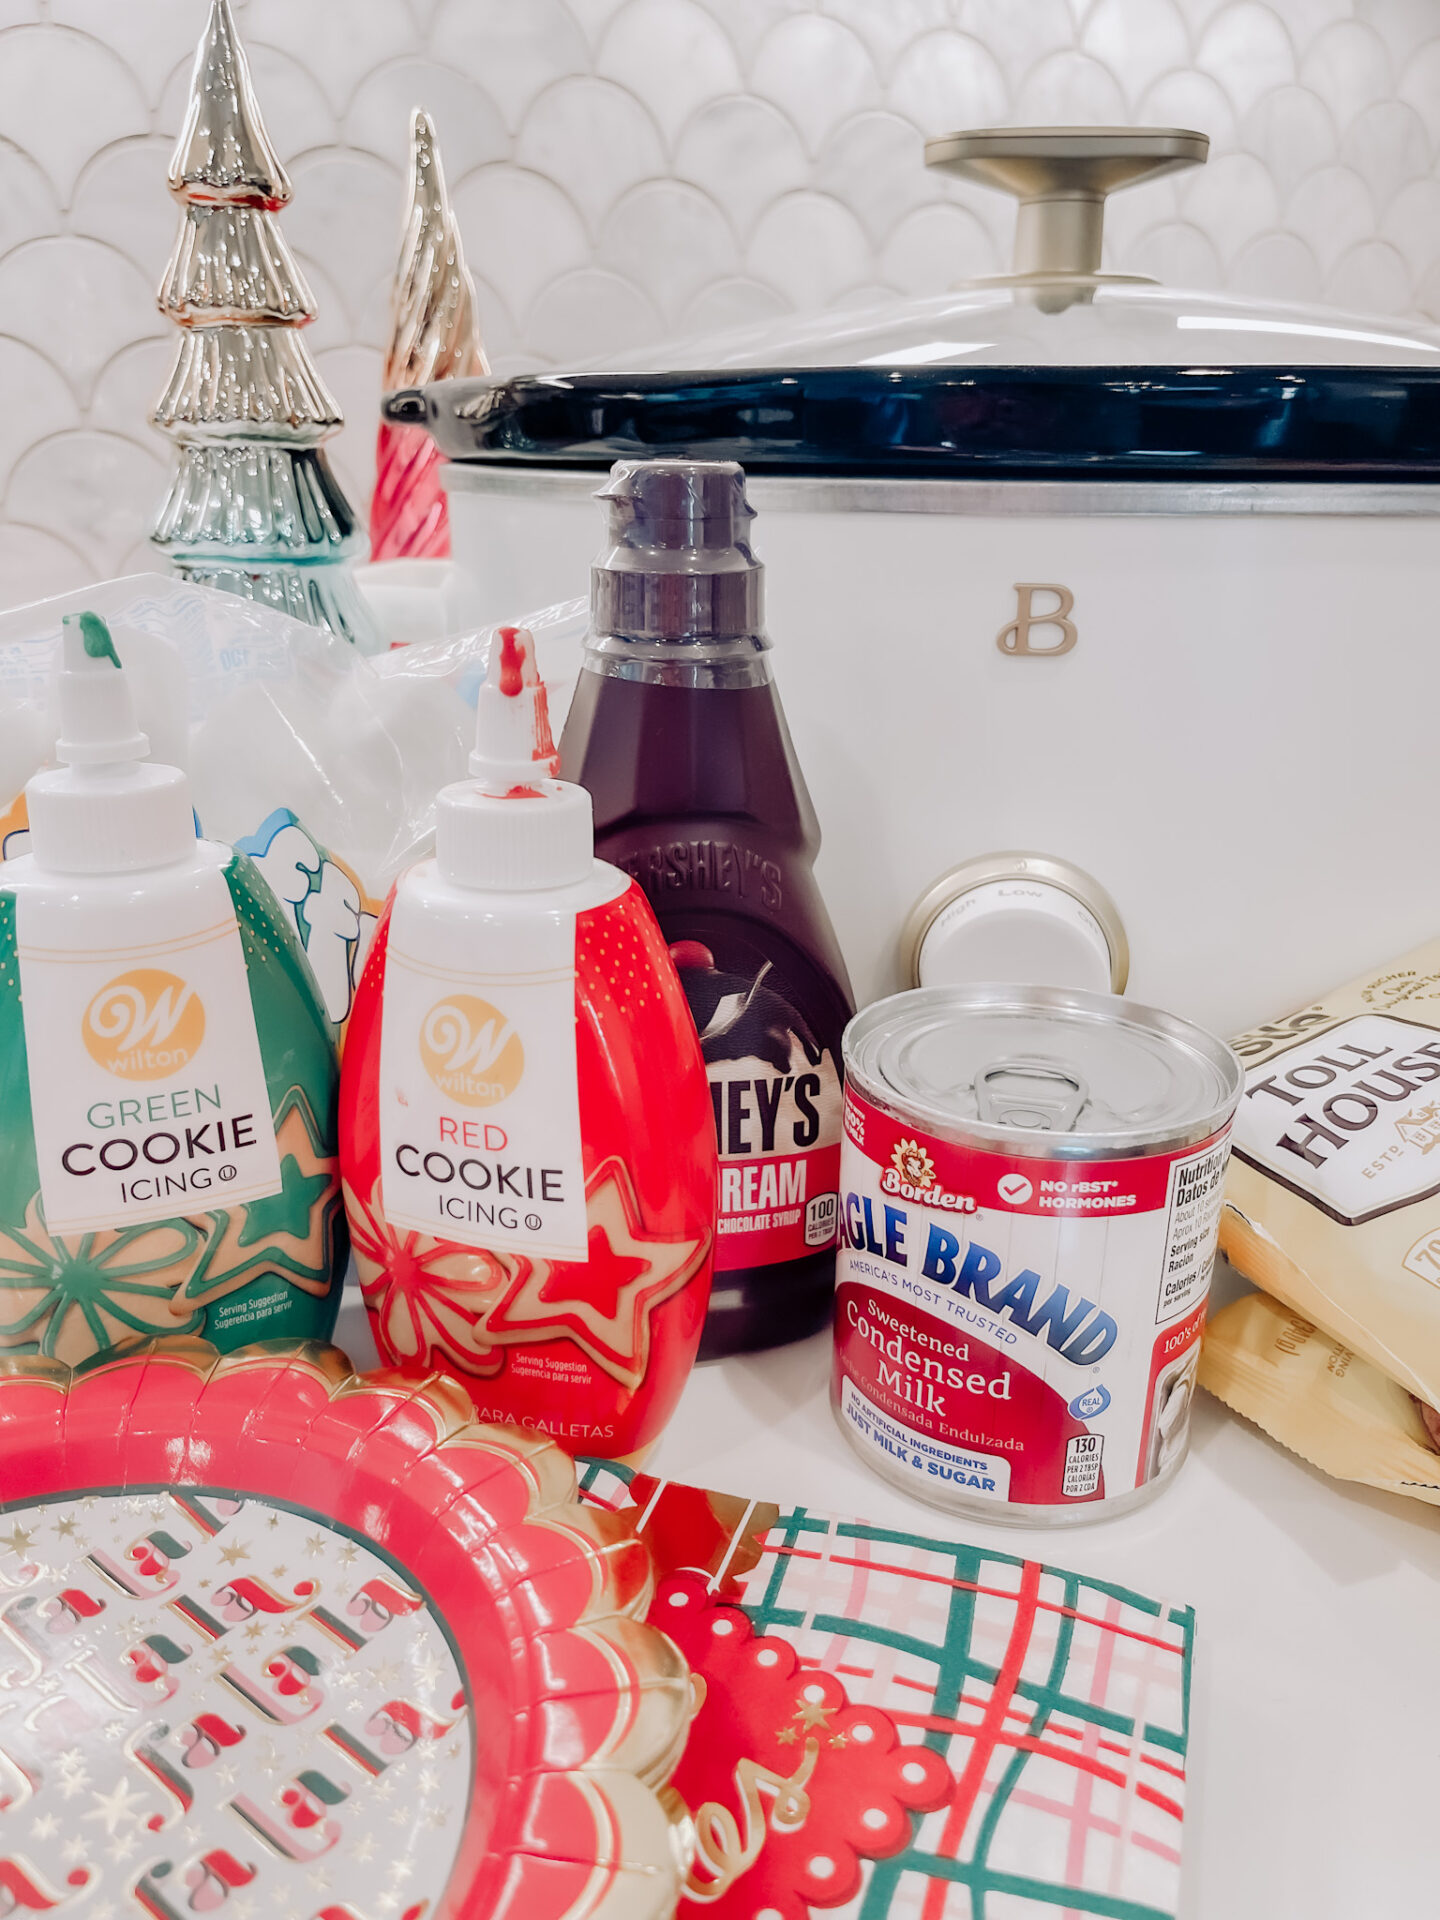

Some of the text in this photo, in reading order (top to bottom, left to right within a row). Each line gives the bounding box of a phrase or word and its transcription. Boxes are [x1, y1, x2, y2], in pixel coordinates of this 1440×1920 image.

[996, 582, 1078, 657] B
[997, 889, 1043, 898] Low
[106, 1048, 189, 1073] wilton
[434, 1071, 506, 1099] wilton
[1245, 1044, 1394, 1107] TOLL
[86, 1083, 222, 1130] GREEN
[61, 1113, 257, 1176] COOKIE
[439, 1116, 509, 1152] RED
[395, 1143, 565, 1203] COOKIE
[1178, 1151, 1223, 1188] Nutrition
[121, 1168, 211, 1204] ICING
[882, 1168, 975, 1212] Borden
[1040, 1180, 1068, 1193] NO
[1176, 1179, 1208, 1207] Datos
[438, 1194, 518, 1229] ICING
[811, 1199, 833, 1221] 100
[1039, 1194, 1136, 1209] HORMONES
[717, 1208, 801, 1235] CHOCOLATE SYRUP
[1170, 1236, 1199, 1257] Serving
[921, 1223, 1118, 1366] BRAND
[1165, 1271, 1197, 1297] Calories
[214, 1300, 293, 1330] Sugerencia para servir
[219, 1291, 288, 1318] Serving Suggestion
[850, 1260, 1018, 1345] AMERICA'S MOST TRUSTED
[868, 1299, 969, 1362] Sweetened
[516, 1353, 587, 1373] Serving Suggestion
[847, 1300, 1012, 1401] Condensed
[512, 1363, 592, 1385] Sugerencia para servir
[876, 1359, 946, 1418] Milk
[1081, 1397, 1101, 1407] REAL
[521, 1415, 614, 1438] GALLETAS
[851, 1391, 988, 1471] NO ARTIFICIAL INGREDIENTS
[938, 1421, 1025, 1452] Endulzada
[846, 1402, 996, 1492] JUST MILK & SUGAR
[1068, 1453, 1099, 1464] CALORIES
[1075, 1437, 1096, 1454] 130
[1066, 1465, 1079, 1474] PER
[1065, 1483, 1078, 1493] POR
